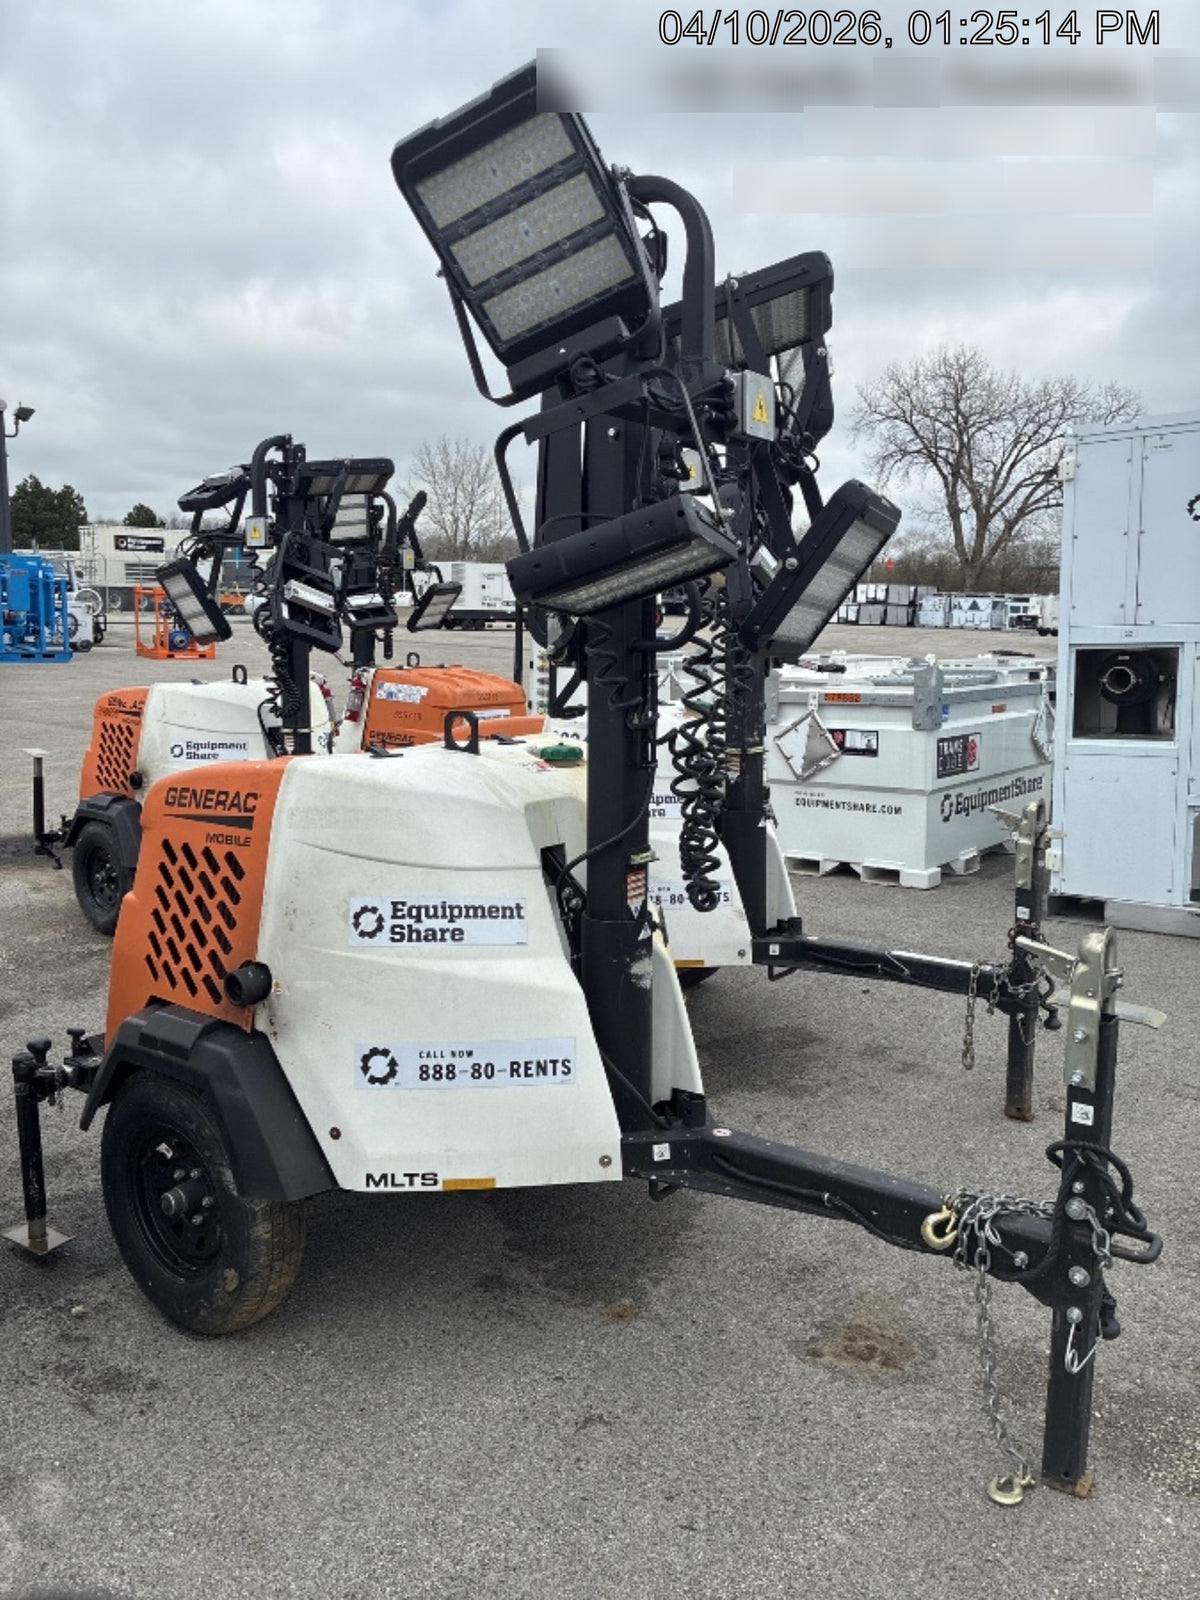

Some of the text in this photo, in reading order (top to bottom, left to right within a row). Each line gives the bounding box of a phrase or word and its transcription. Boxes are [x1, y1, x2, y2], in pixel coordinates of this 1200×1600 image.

[185, 741, 248, 751] Equipment
[185, 751, 219, 760] Share
[164, 787, 259, 813] GENERAC
[954, 776, 1043, 817] EquipmentShare
[795, 798, 903, 815] EQUIPMENTSHARE.COM
[205, 832, 252, 847] MOBILE
[390, 900, 525, 923] Equipment
[390, 924, 465, 943] Share
[418, 1049, 474, 1059] CALL NOW
[418, 1058, 573, 1082] 888-80-RENTS
[365, 1172, 439, 1188] MLTS
